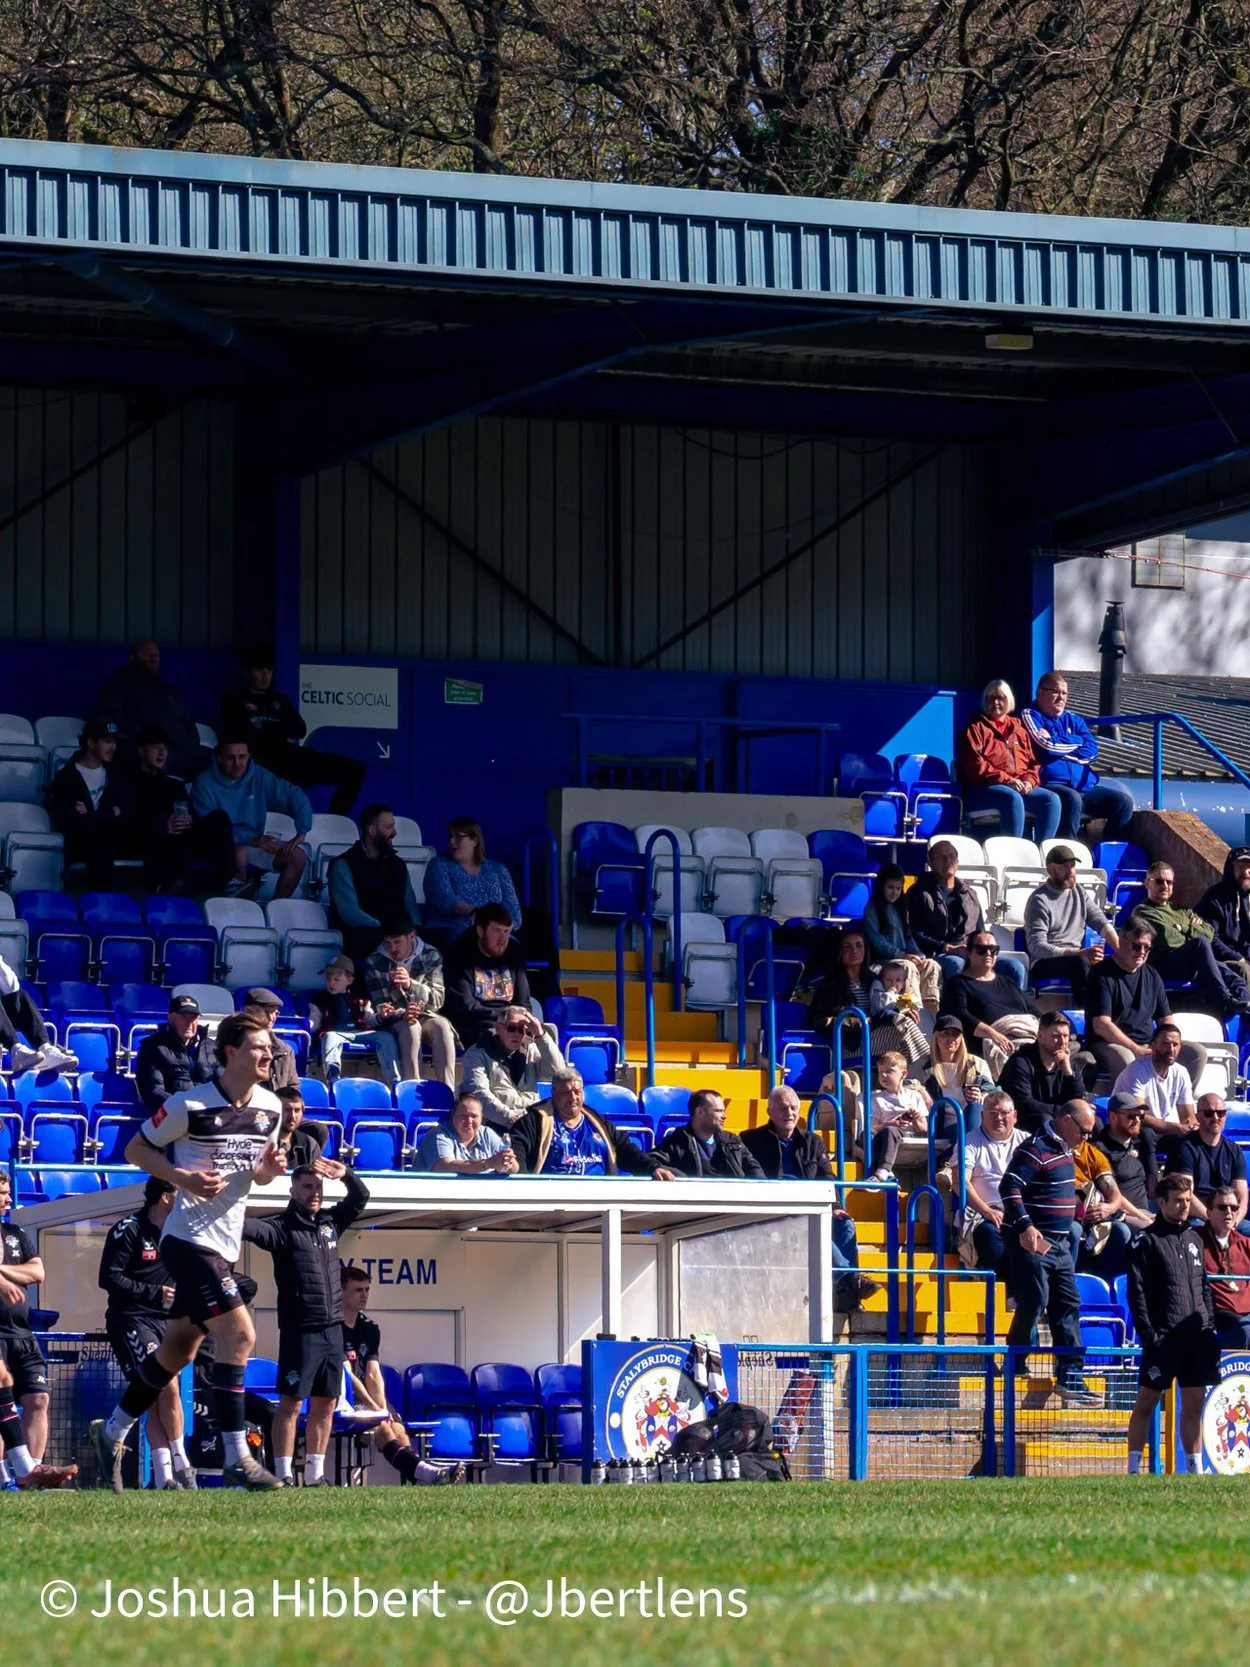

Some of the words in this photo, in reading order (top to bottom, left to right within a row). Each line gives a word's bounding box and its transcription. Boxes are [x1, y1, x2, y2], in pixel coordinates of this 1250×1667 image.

[301, 690, 344, 704] CELTIC
[346, 692, 391, 707] SOCIAL
[227, 1138, 252, 1151] Hyde
[361, 1258, 437, 1285] TEAM
[616, 1353, 682, 1398] STALYBRIDGE
